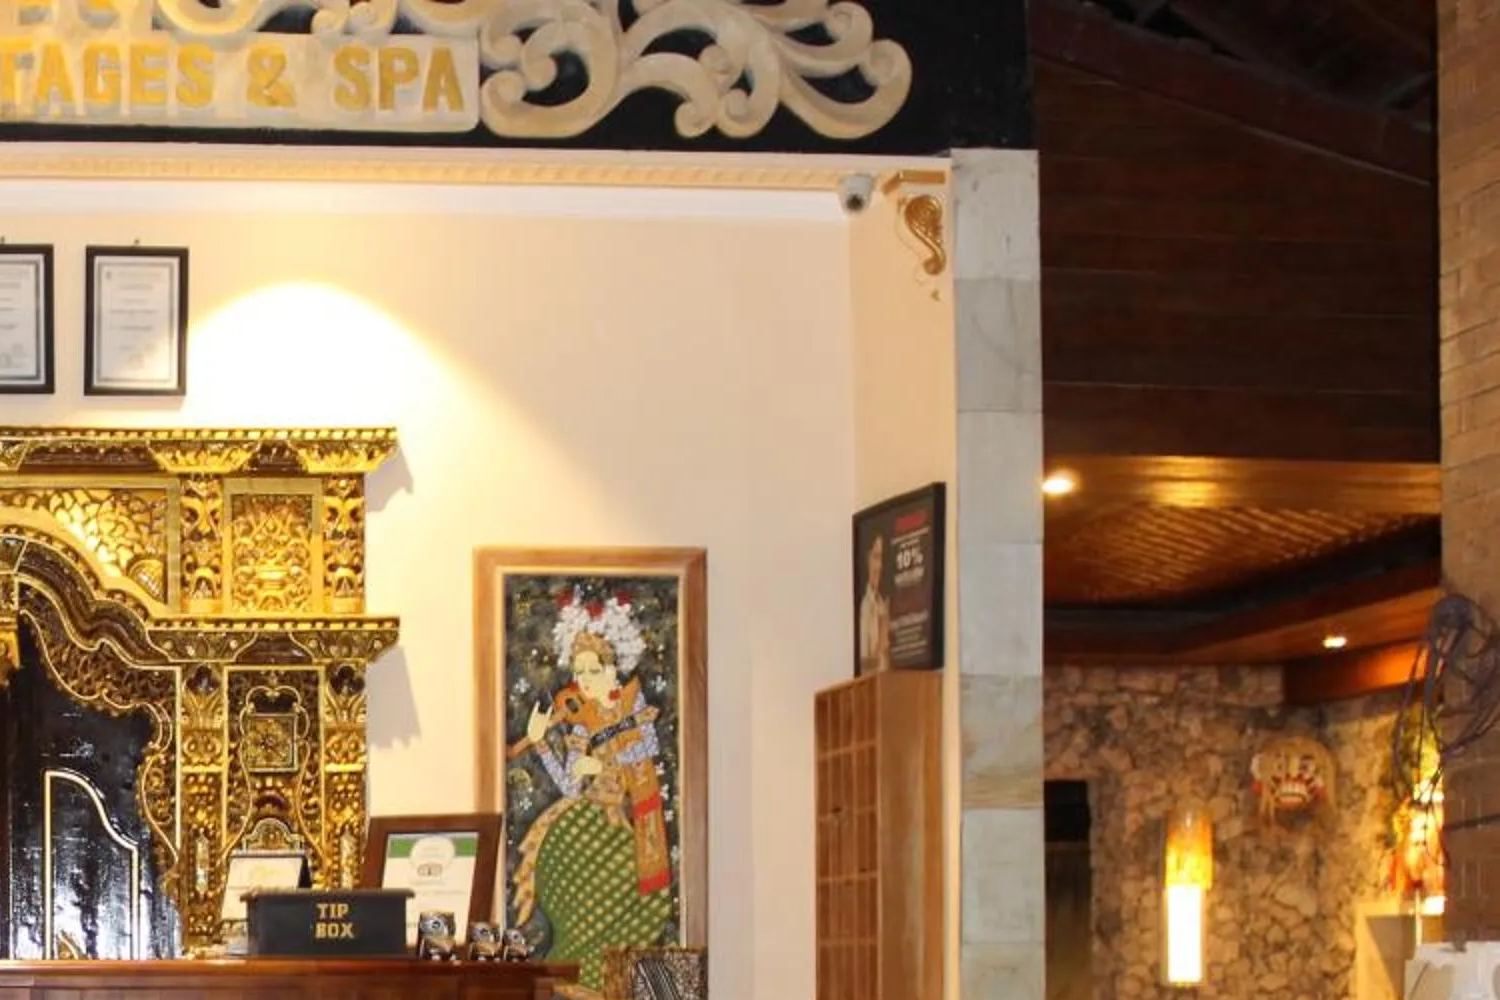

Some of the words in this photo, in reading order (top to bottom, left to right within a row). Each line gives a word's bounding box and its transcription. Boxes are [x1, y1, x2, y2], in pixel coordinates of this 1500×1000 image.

[246, 42, 296, 108] &
[333, 45, 465, 112] SPA
[316, 902, 350, 919] TIP
[314, 921, 356, 939] BOX
